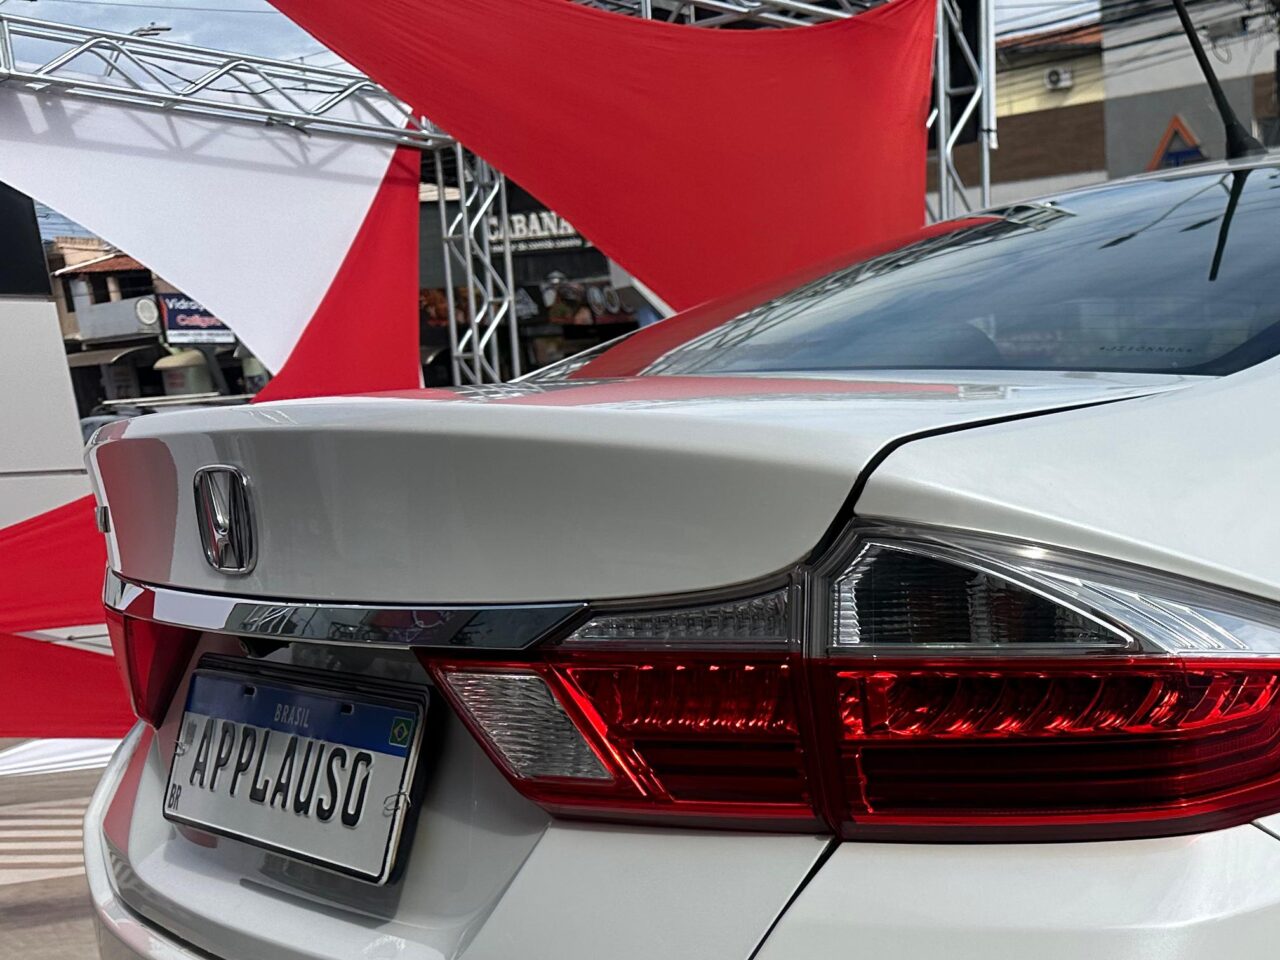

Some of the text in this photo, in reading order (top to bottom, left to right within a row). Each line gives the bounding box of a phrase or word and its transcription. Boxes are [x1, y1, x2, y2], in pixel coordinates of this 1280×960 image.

[274, 703, 311, 728] BRASIL
[189, 718, 375, 828] APPLAUSO
[167, 783, 183, 811] BR
